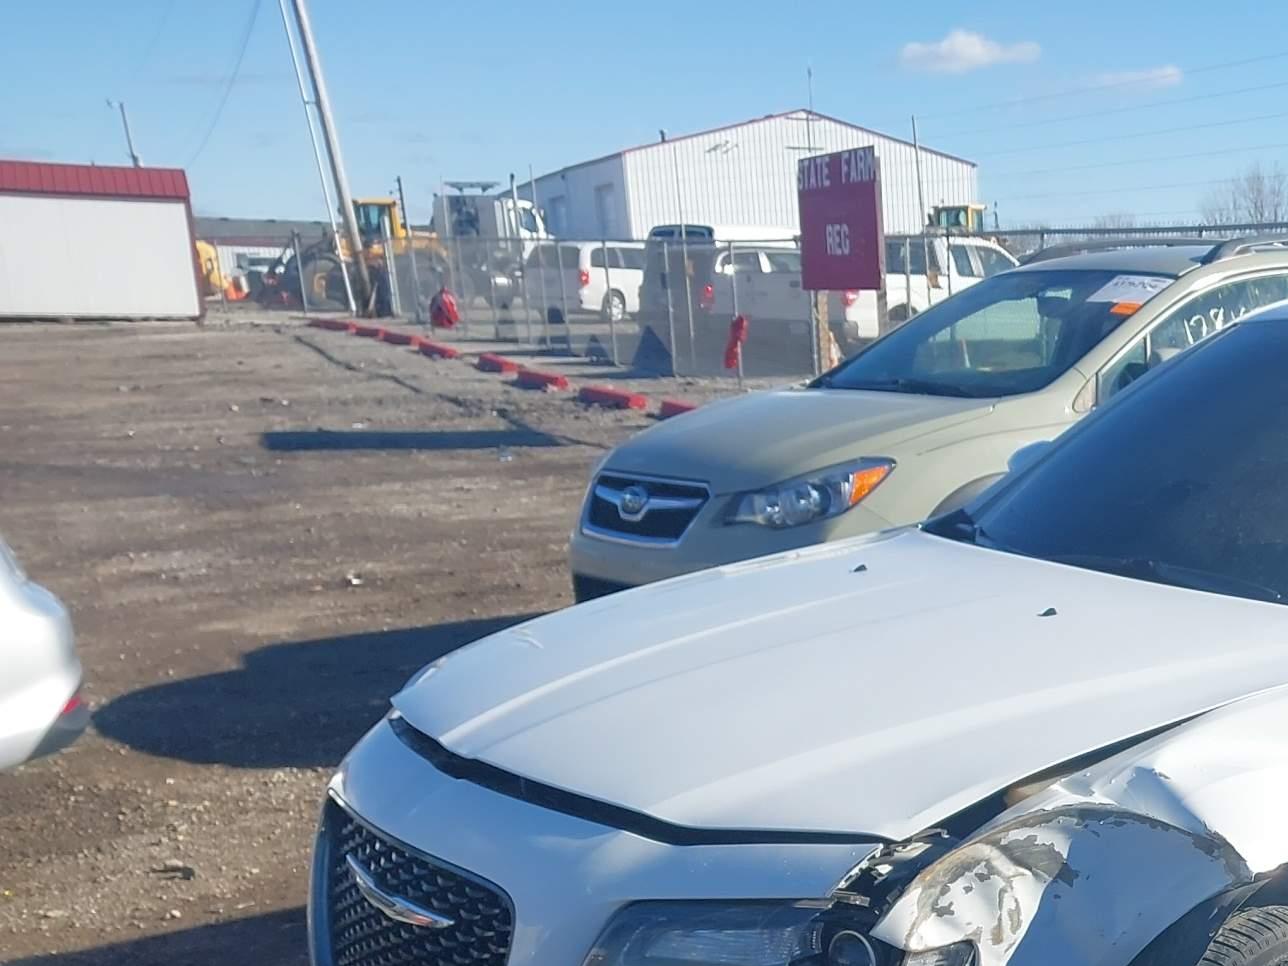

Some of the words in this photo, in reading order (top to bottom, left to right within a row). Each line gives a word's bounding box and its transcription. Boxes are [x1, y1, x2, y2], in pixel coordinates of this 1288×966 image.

[798, 156, 831, 191] STATE
[841, 148, 875, 184] FARM
[826, 223, 850, 255] REG
